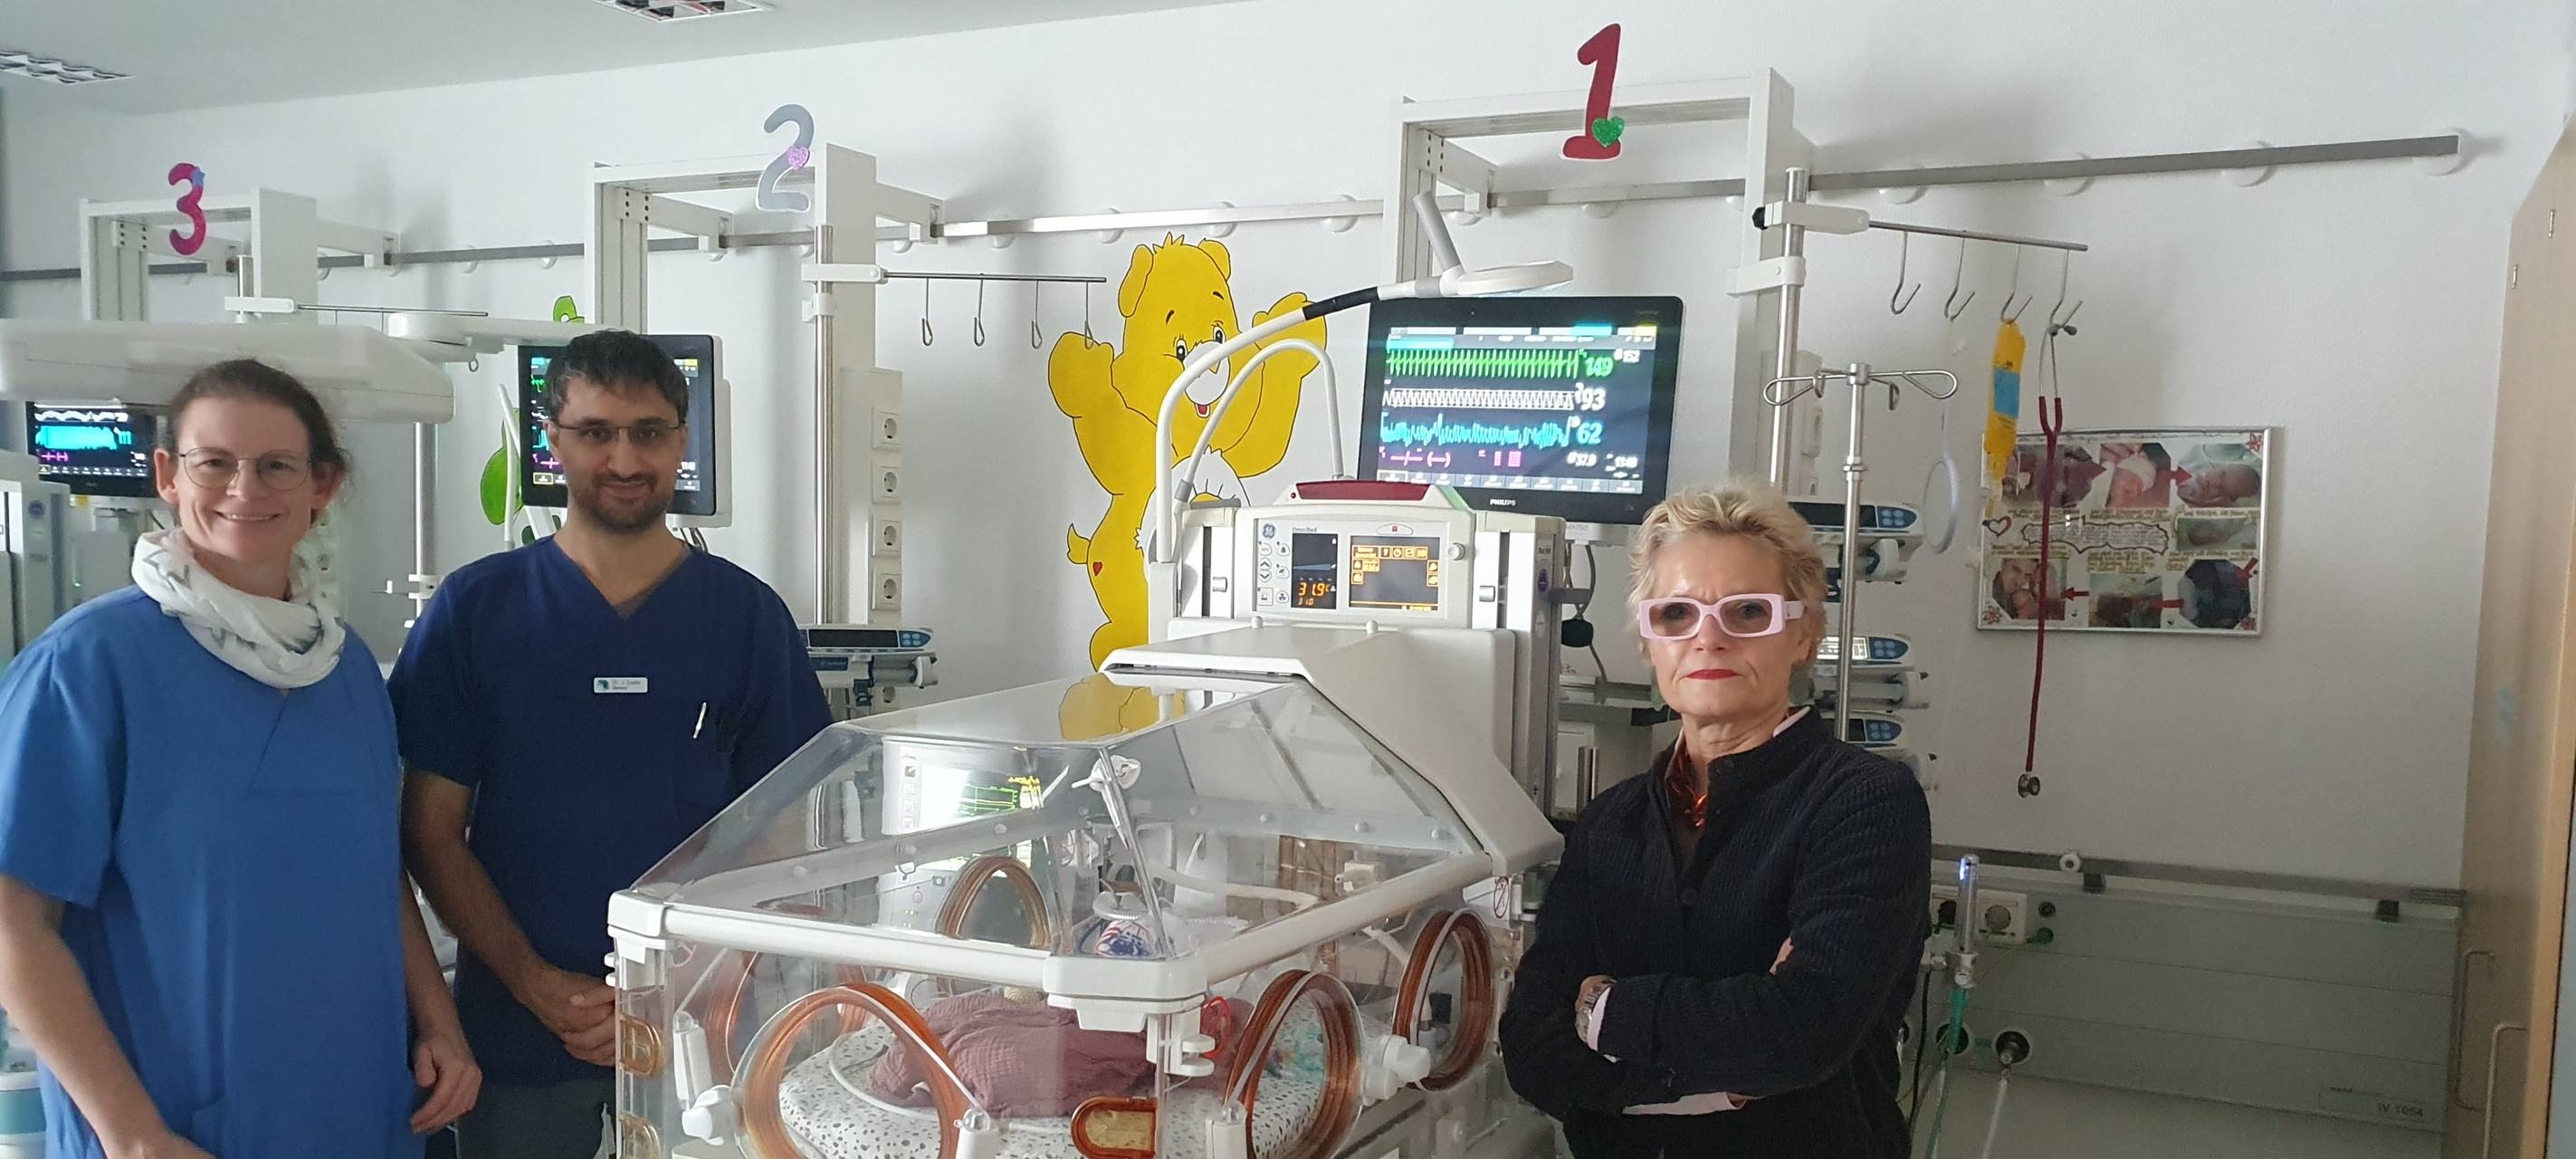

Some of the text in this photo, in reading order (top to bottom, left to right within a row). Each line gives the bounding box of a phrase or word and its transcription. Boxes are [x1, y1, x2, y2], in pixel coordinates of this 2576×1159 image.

[1562, 23, 1621, 159] 1
[758, 103, 815, 212] 2
[168, 162, 206, 255] 3
[1586, 357, 1614, 377] 149
[1581, 388, 1607, 411] 93
[1577, 422, 1602, 445] 62
